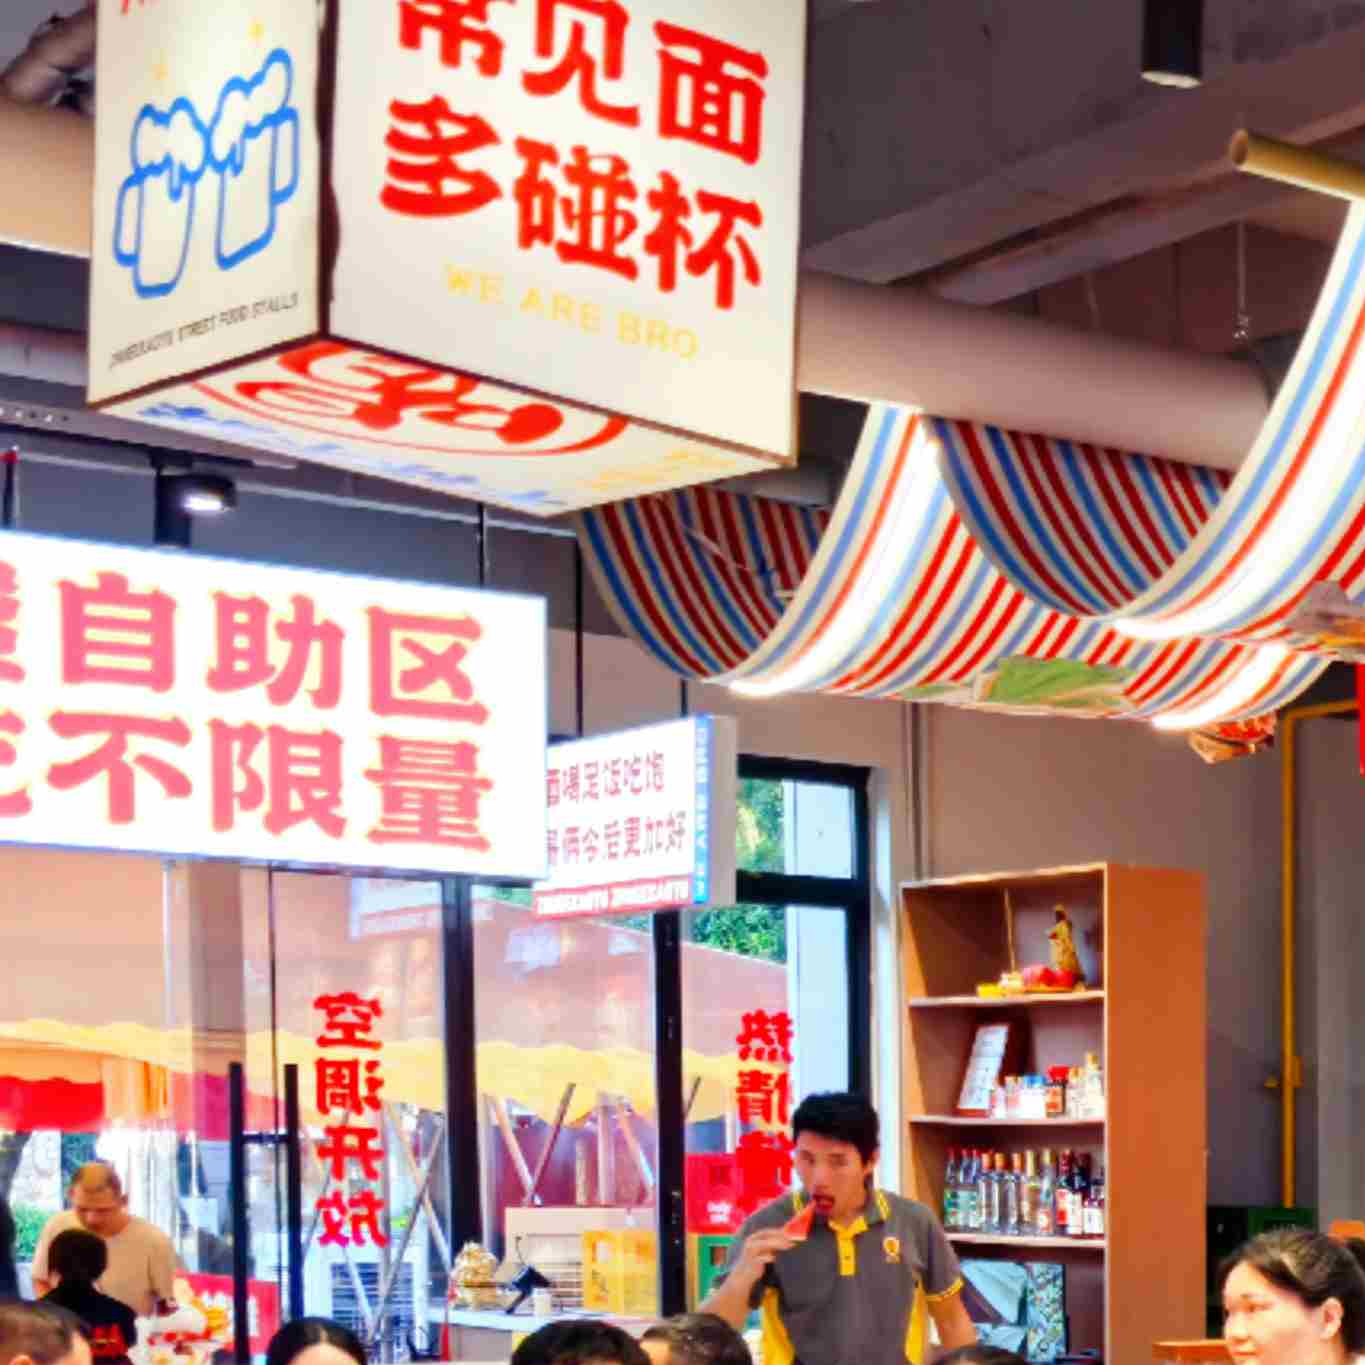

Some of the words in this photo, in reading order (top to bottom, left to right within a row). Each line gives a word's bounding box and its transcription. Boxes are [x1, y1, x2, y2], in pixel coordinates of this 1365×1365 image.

[379, 95, 762, 310] 多碰杯
[445, 263, 505, 305] WE
[520, 286, 601, 333] ARE
[617, 311, 699, 360] BRO
[0, 560, 492, 726] 自助区
[0, 707, 495, 853] 不限量
